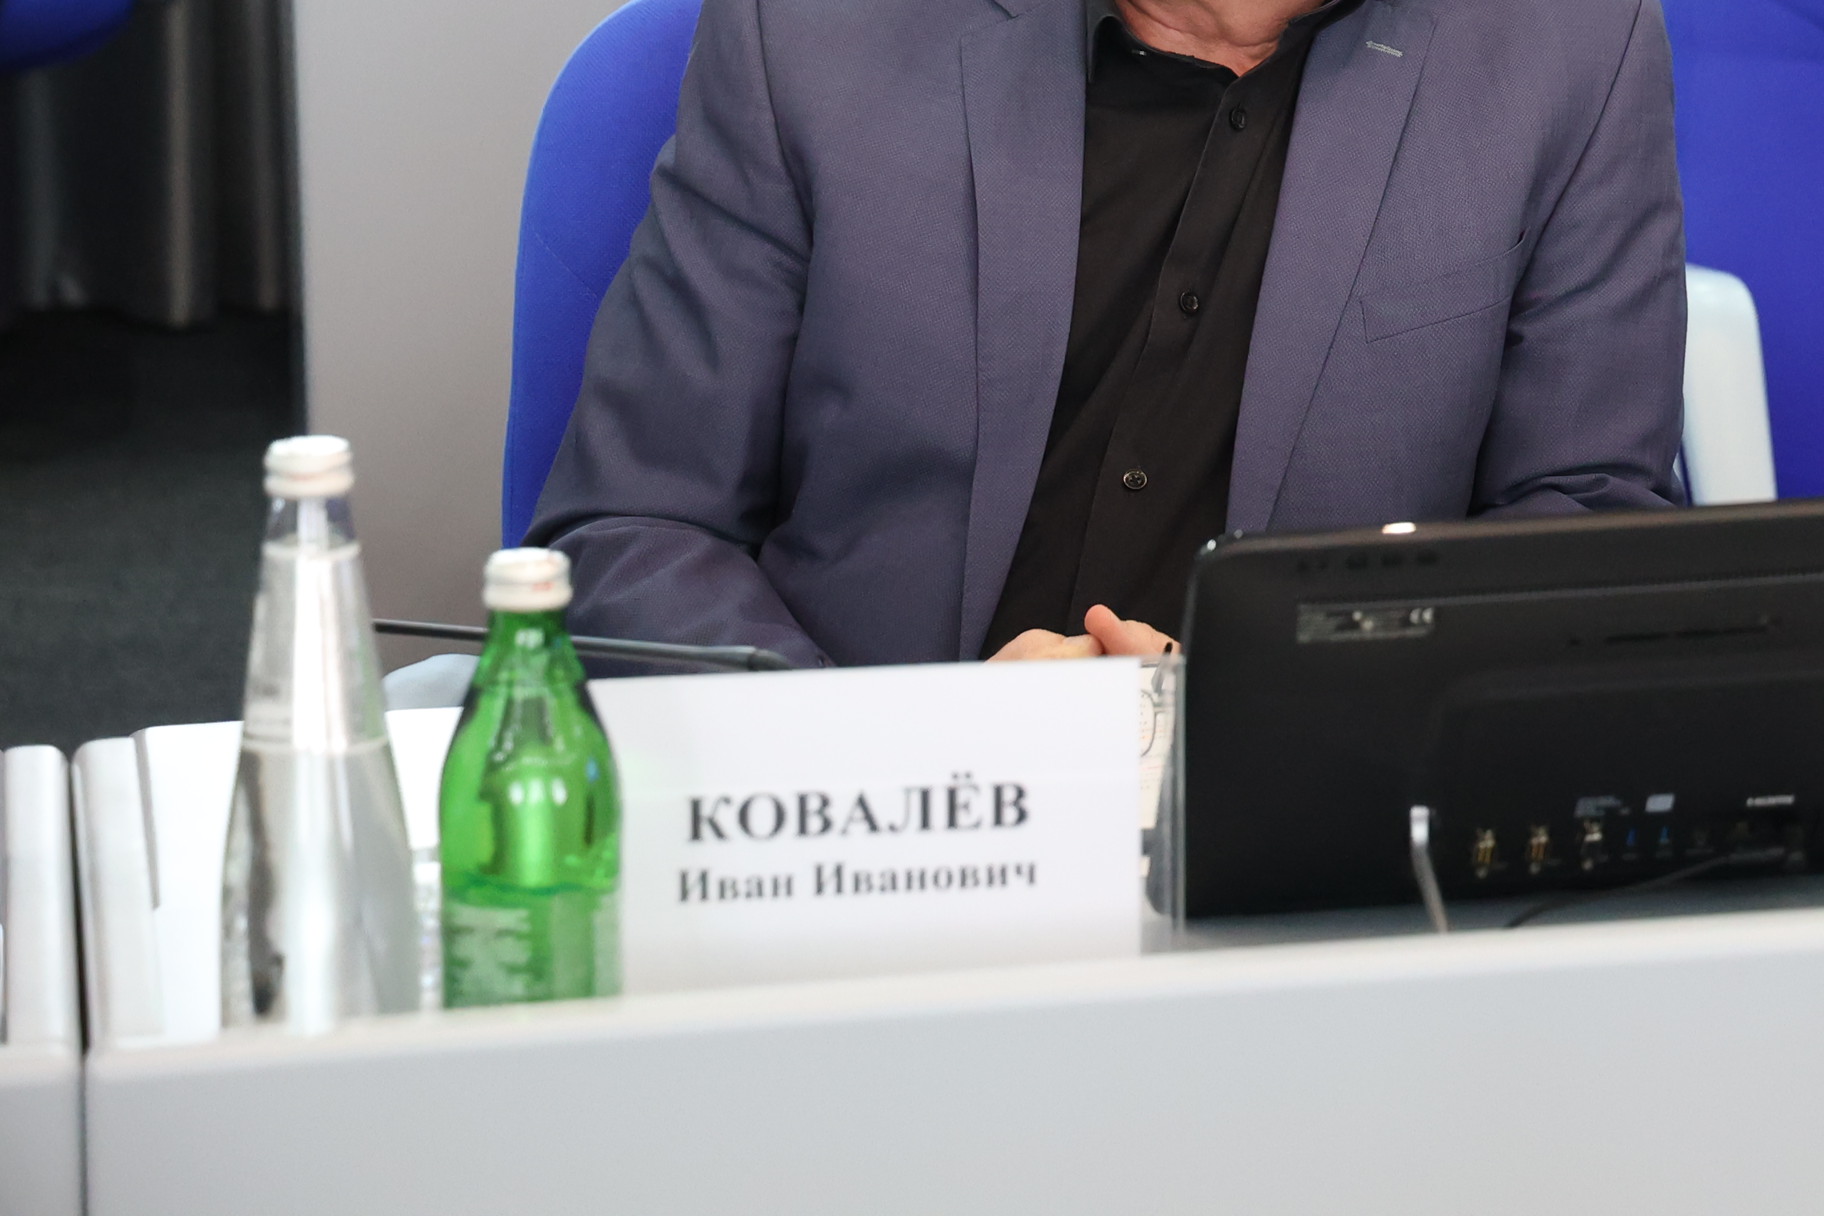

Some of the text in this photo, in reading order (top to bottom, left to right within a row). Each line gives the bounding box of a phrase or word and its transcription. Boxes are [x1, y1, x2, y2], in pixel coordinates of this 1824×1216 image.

[687, 770, 1030, 844] КОВАЛЁВ
[678, 861, 1037, 903] Иван Иванович
